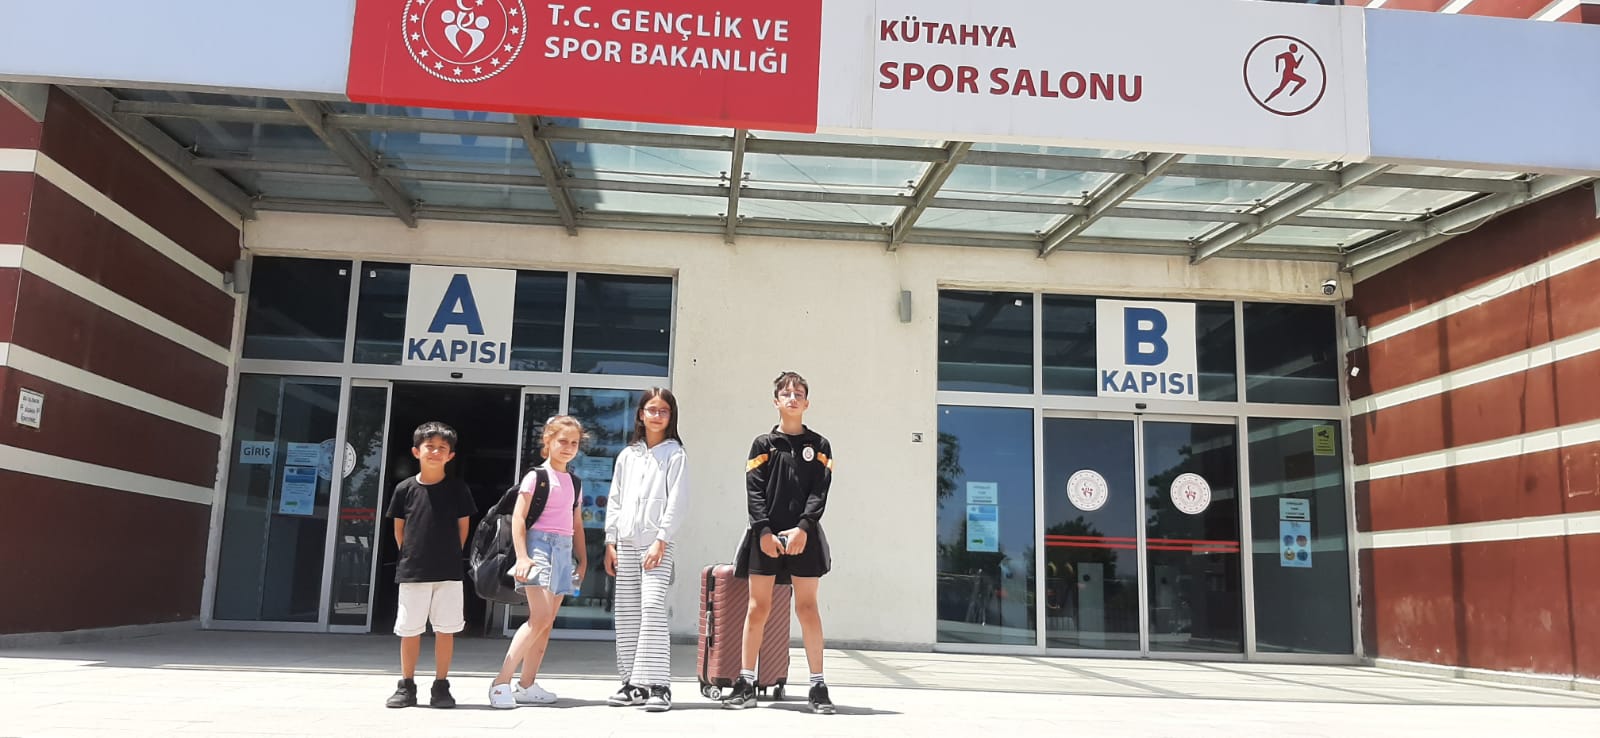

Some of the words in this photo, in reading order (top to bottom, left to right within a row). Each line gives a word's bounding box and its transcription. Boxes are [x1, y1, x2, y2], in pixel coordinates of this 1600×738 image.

[547, 4, 600, 29] T.C.
[611, 9, 742, 41] GENÇLİK
[752, 18, 789, 42] VE
[880, 16, 1017, 48] KÜTAHYA
[544, 36, 621, 63] SPOR
[630, 43, 788, 74] BAKANLIĞI
[879, 61, 979, 94] SPOR
[989, 67, 1142, 102] SALONU
[427, 273, 485, 335] A
[407, 338, 507, 364] KAPISI
[1123, 306, 1169, 366] B
[1101, 370, 1194, 395] KAPISI
[243, 445, 271, 458] GİRİŞ
